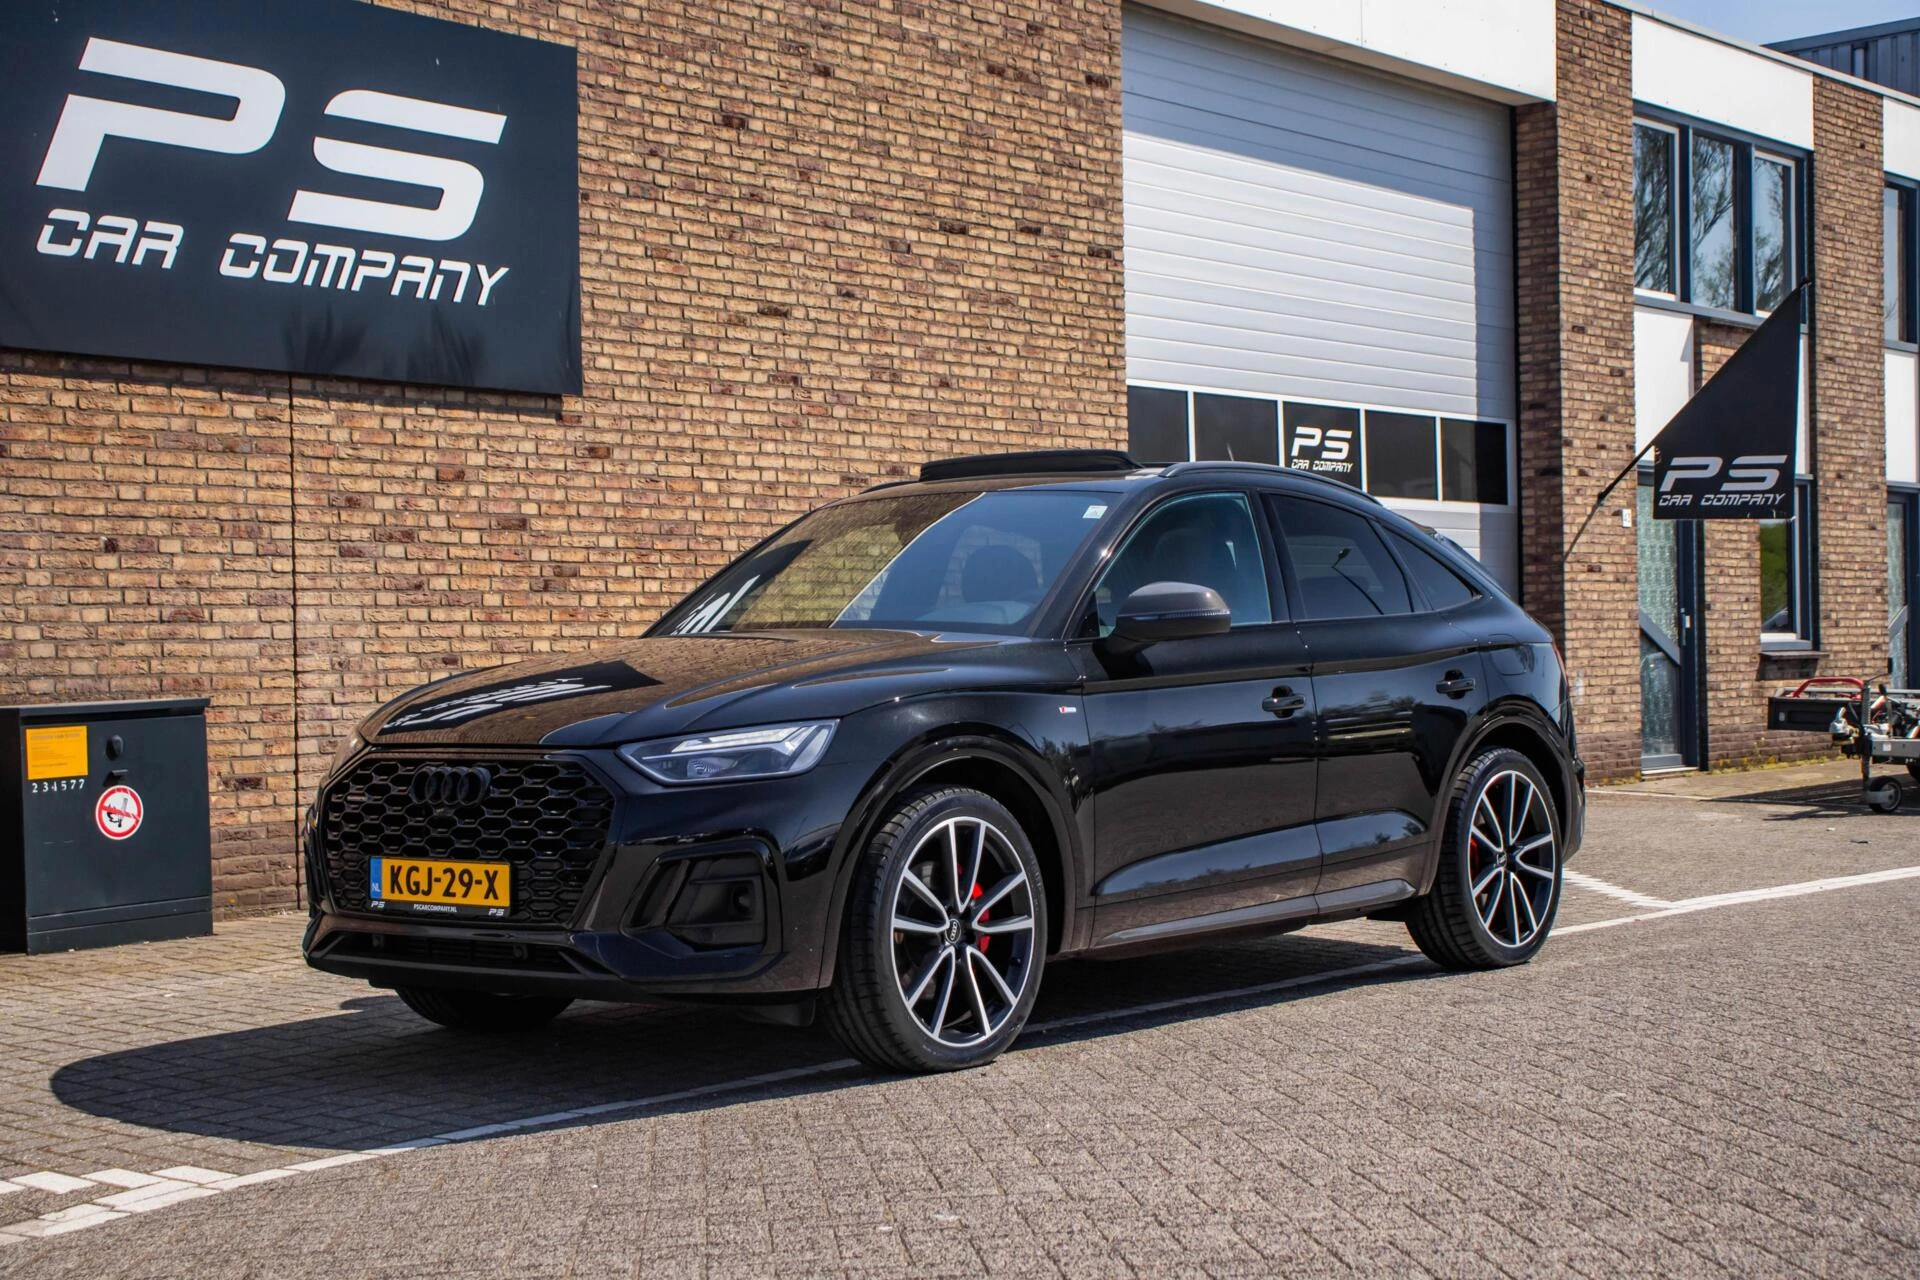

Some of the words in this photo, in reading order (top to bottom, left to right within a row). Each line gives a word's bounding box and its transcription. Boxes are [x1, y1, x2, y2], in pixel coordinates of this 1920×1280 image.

[36, 37, 507, 241] PS
[36, 208, 184, 269] CAR
[219, 233, 509, 306] COMPANY
[1291, 426, 1352, 460] PS
[1291, 459, 1310, 470] CAR
[1313, 460, 1353, 472] COMPANY
[1659, 455, 1788, 492] PS
[1658, 494, 1693, 506] CAR
[1700, 493, 1786, 506] COMPANY
[32, 779, 85, 793] 234577
[371, 882, 380, 893] NL
[390, 865, 499, 900] KGJ-29-X
[413, 903, 458, 913] PSCARCOMPANY.NL
[488, 908, 504, 916] PS
